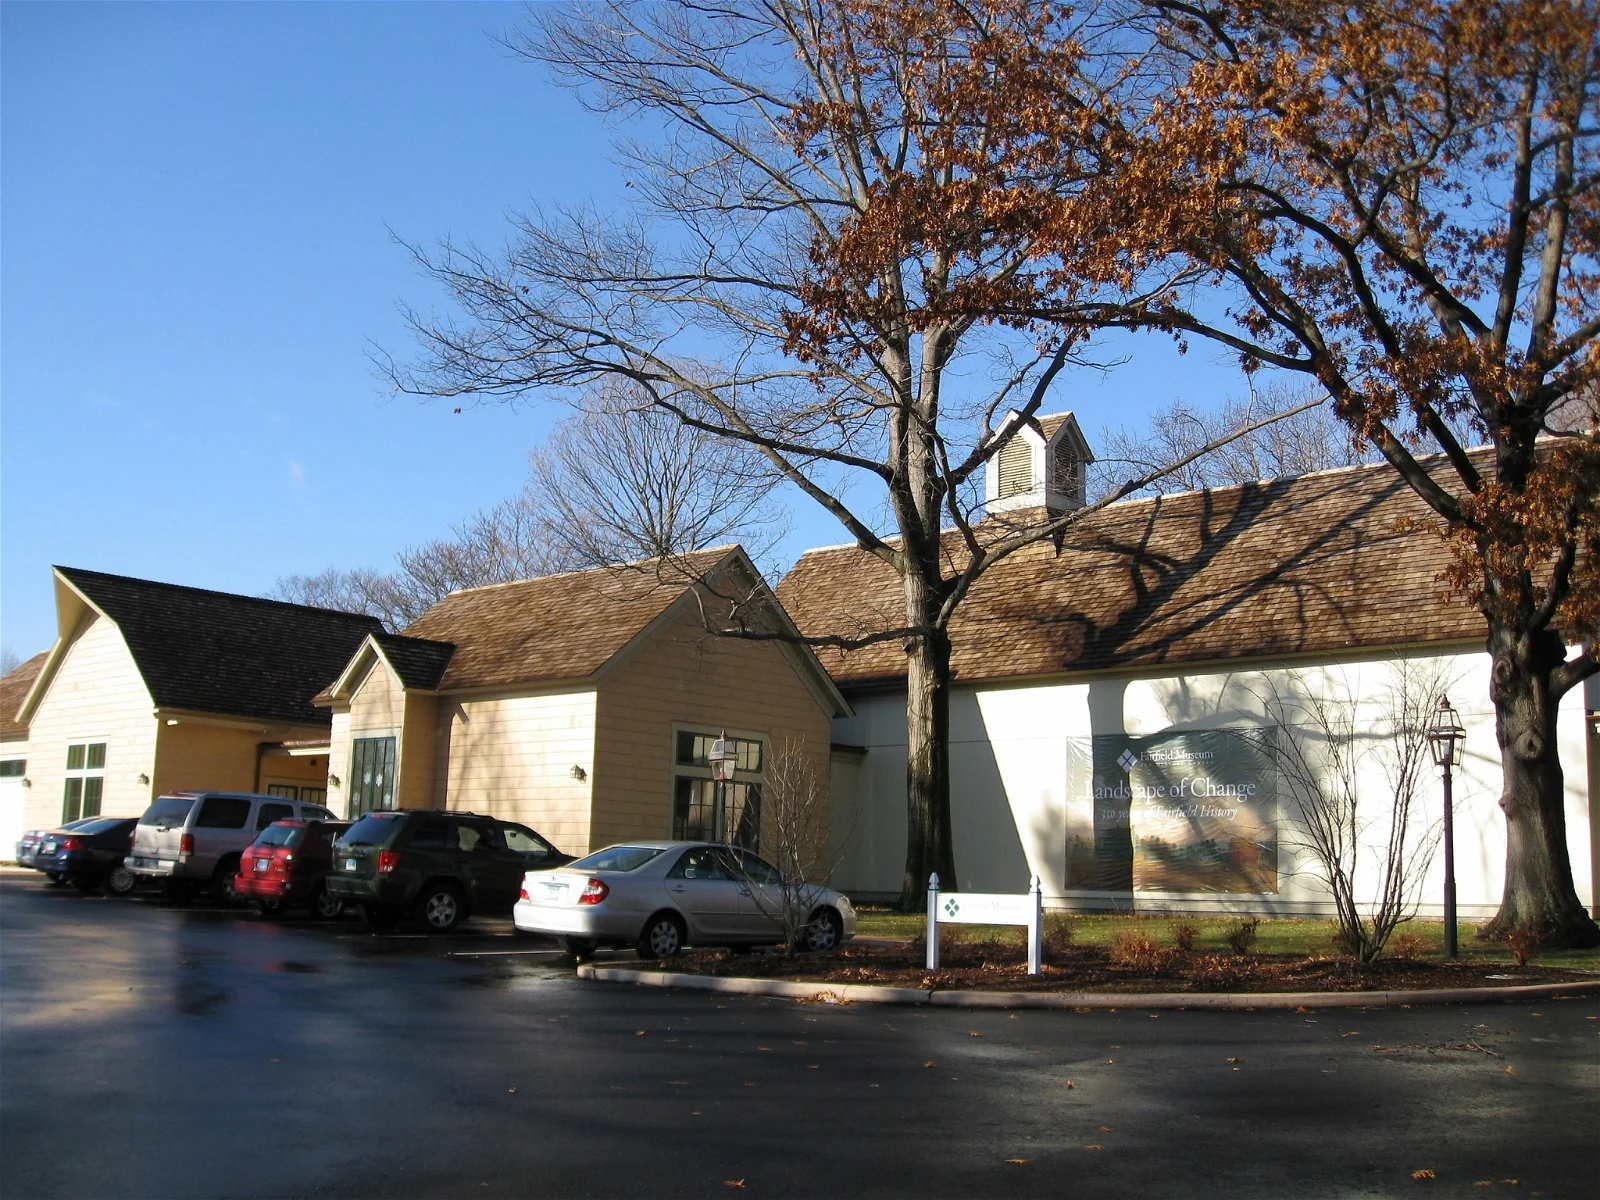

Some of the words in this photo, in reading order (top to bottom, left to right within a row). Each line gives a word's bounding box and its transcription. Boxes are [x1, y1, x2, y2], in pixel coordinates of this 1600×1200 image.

[1174, 749, 1213, 760] Museum
[1084, 779, 1165, 805] Landscape
[1170, 777, 1189, 798] of
[1190, 776, 1256, 803] Change
[1100, 810, 1116, 821] 350
[1156, 804, 1199, 821] Fairfield
[1200, 804, 1238, 821] History
